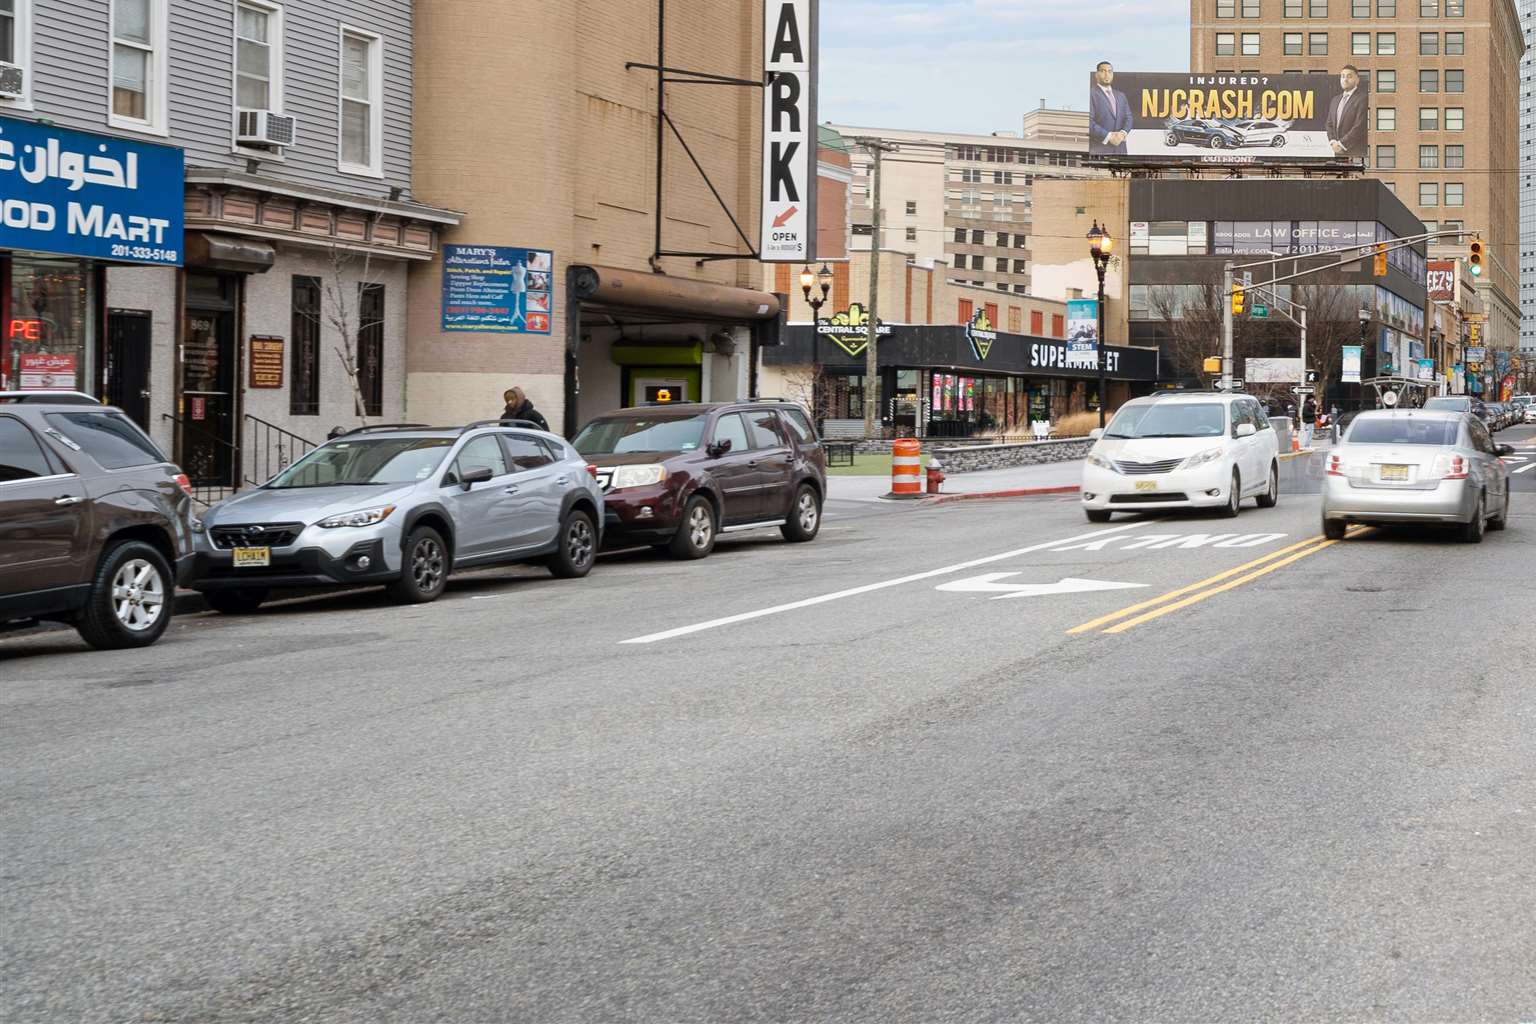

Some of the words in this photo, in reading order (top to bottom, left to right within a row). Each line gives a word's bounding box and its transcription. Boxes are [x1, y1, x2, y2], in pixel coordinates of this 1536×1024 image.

[1190, 77, 1269, 85] INJURED?
[1141, 88, 1314, 121] NJCRASH.COM
[67, 201, 170, 245] MART
[772, 232, 797, 241] OPEN
[1255, 228, 1287, 238] LAW
[1292, 228, 1341, 238] OFFICE
[111, 244, 177, 262] 201-333-5148
[456, 247, 497, 256] MARY'S
[817, 326, 854, 334] CENTRAL
[854, 326, 891, 335] SQARE
[1071, 343, 1093, 351] STEM
